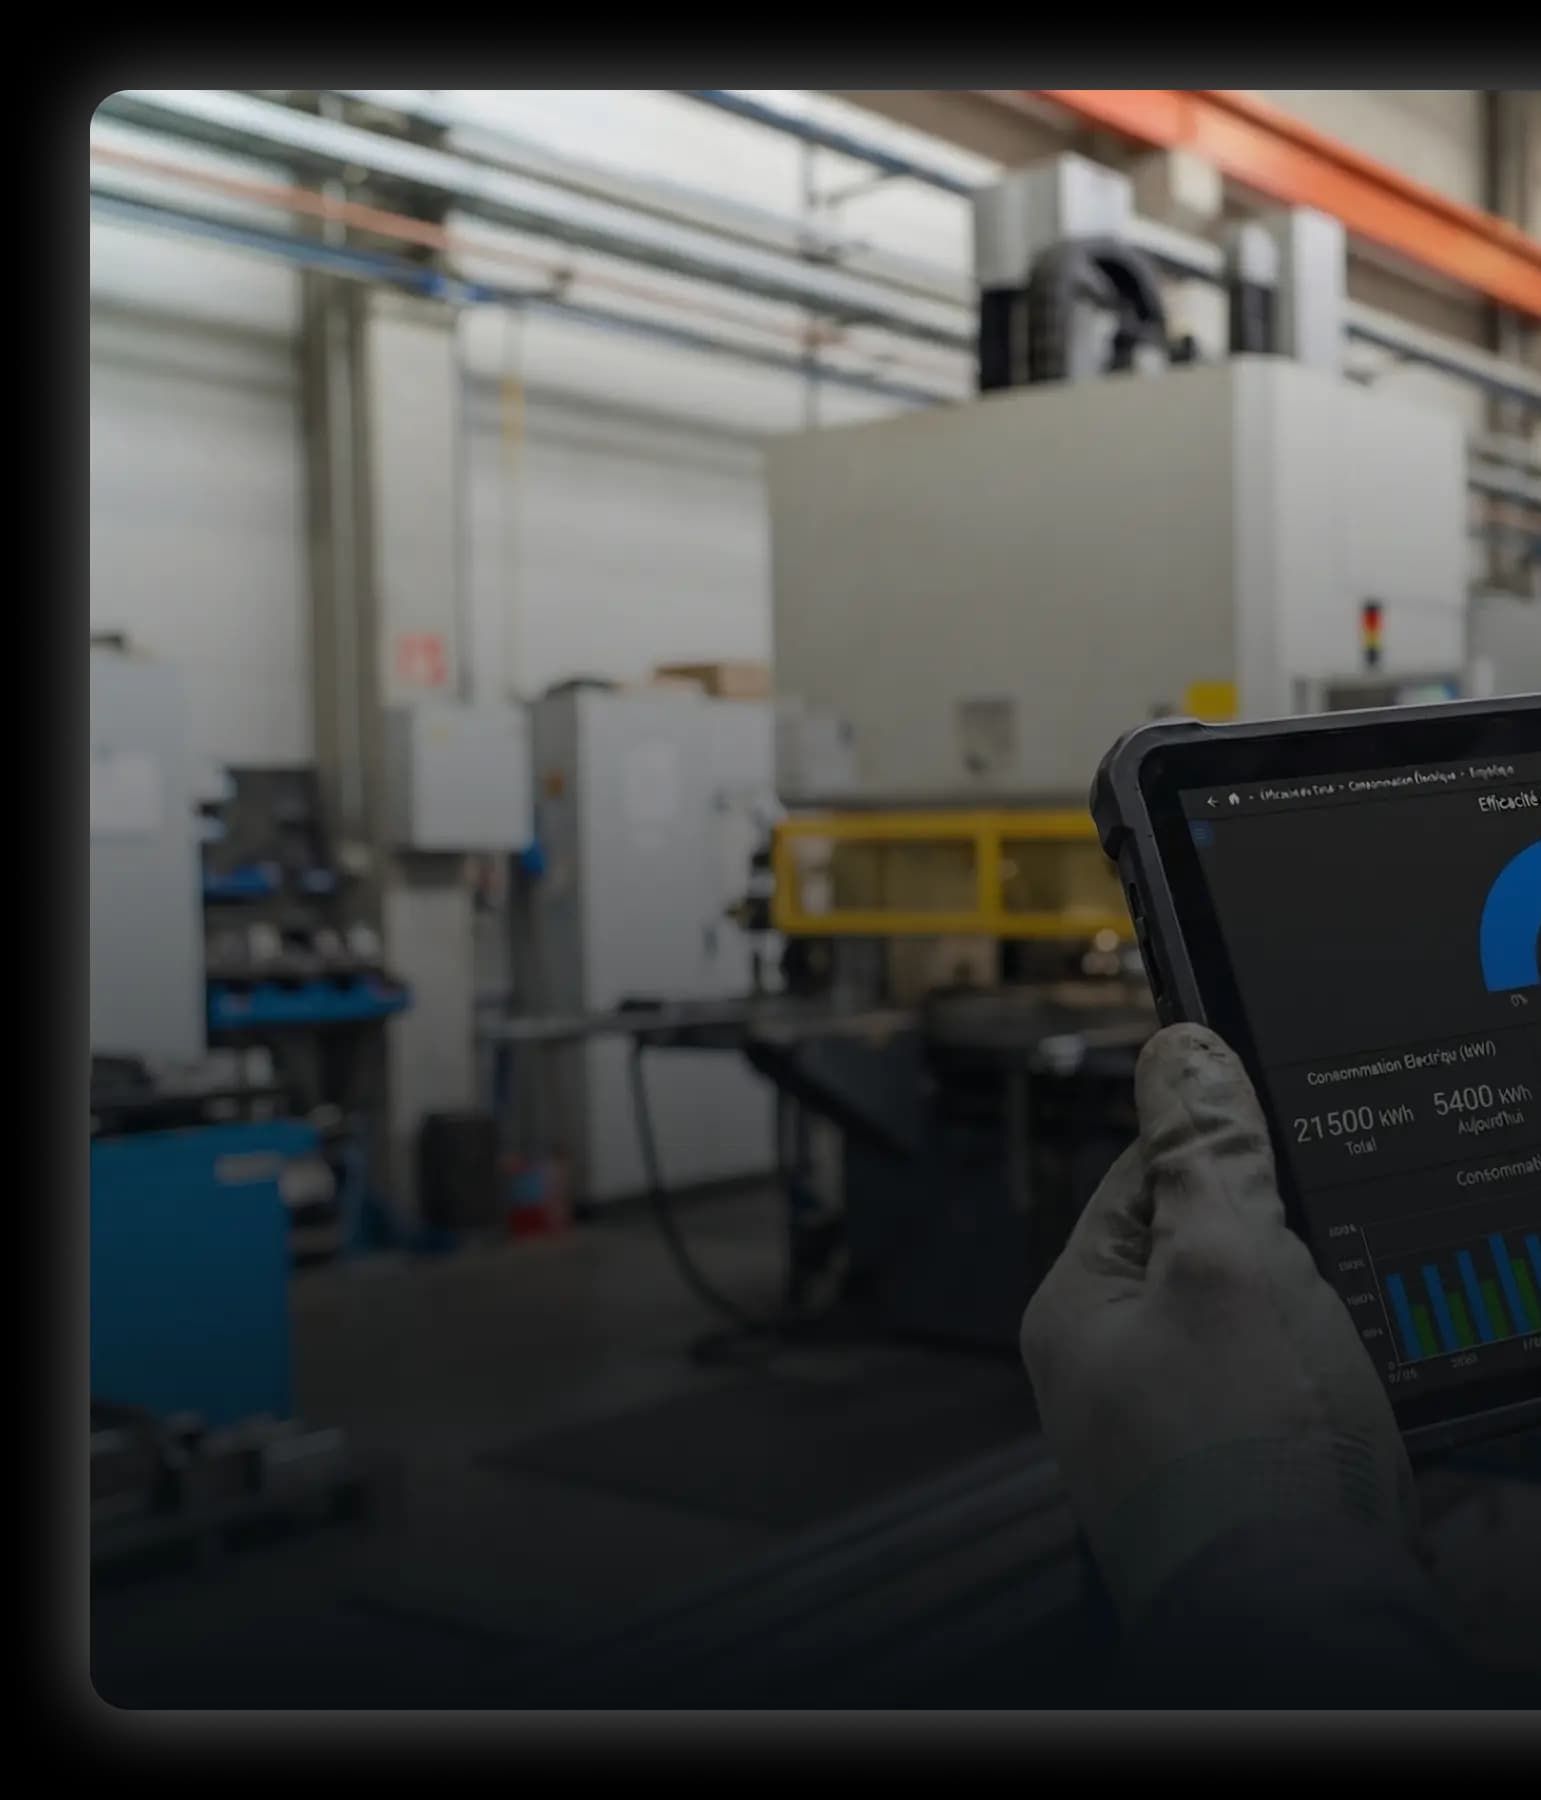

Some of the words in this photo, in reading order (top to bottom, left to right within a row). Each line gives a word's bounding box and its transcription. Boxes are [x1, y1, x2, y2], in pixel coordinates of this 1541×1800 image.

[1432, 1083, 1493, 1117] 5400
[1498, 1083, 1534, 1106] kWh
[1378, 1103, 1415, 1128] kWh
[1344, 1135, 1378, 1157] Total
